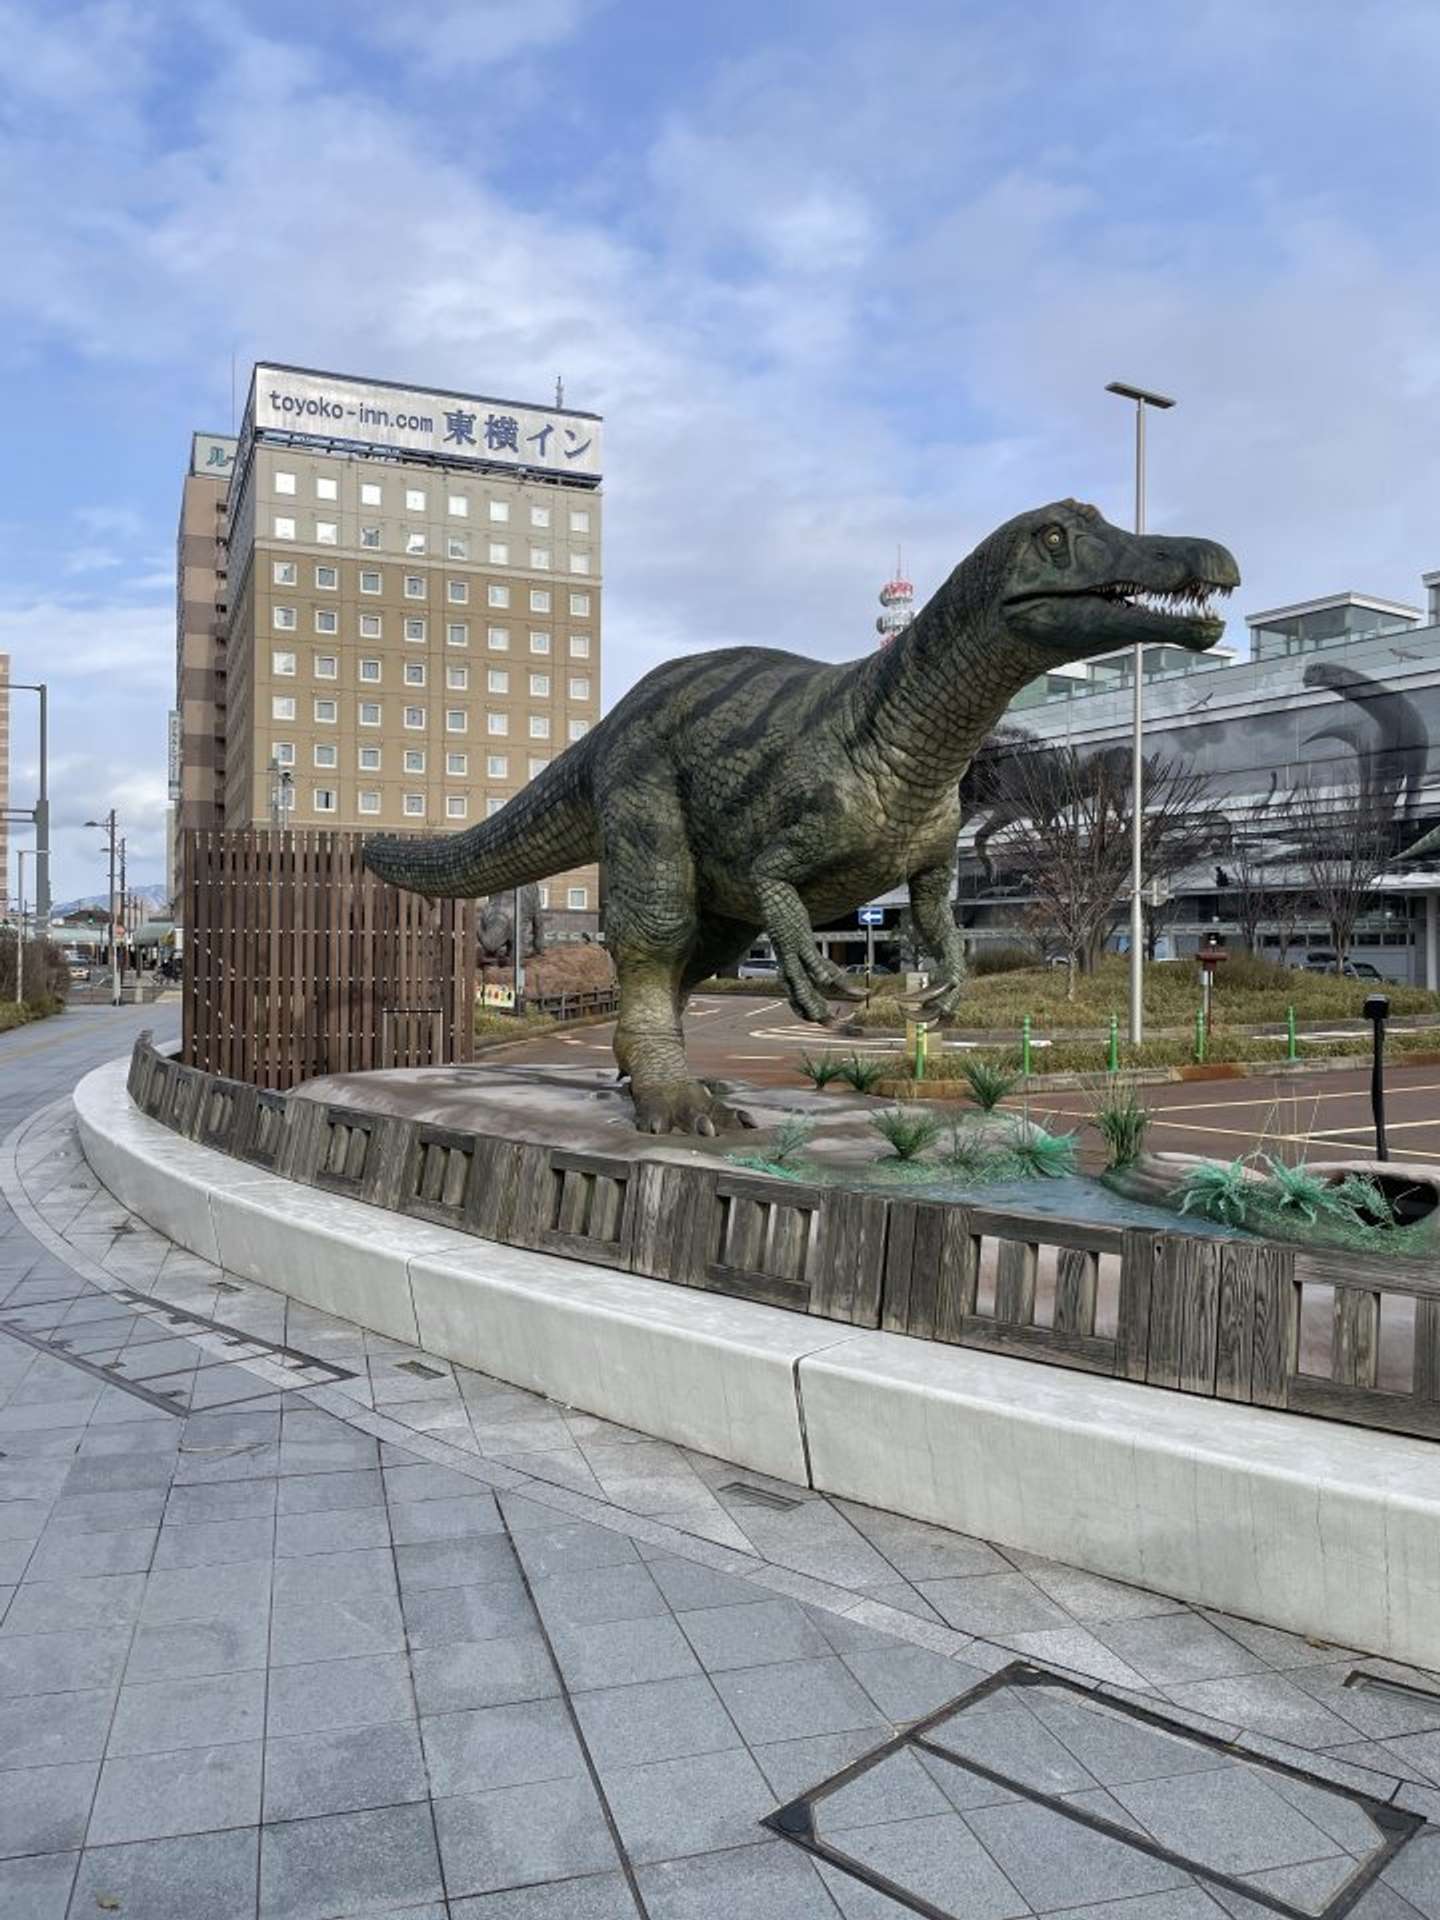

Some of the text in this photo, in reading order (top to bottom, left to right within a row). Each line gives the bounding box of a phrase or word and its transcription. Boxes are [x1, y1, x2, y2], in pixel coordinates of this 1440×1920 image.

[269, 390, 433, 432] toyoko-inn.com
[443, 410, 592, 459] 東横イン
